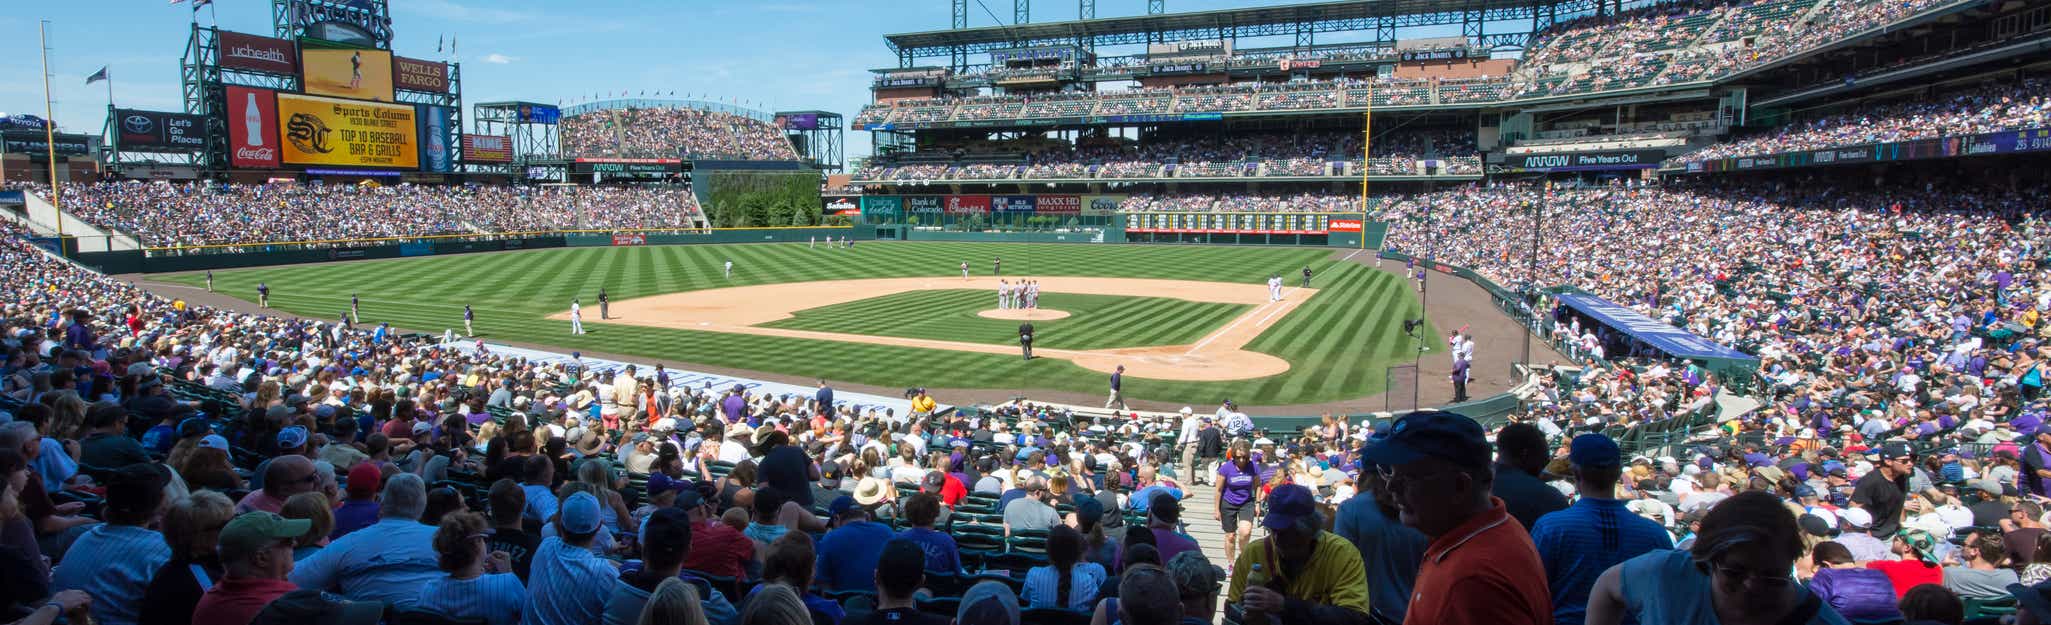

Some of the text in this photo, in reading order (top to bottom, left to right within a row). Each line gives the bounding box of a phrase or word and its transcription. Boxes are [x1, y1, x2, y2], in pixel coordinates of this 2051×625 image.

[231, 44, 285, 62] uchealth
[400, 61, 440, 76] WELLS
[400, 72, 441, 87] FARGO
[334, 104, 411, 121] Sports Column
[10, 118, 42, 127] TOYOTA
[169, 118, 192, 127] Let's
[169, 127, 184, 135] Go
[170, 136, 203, 145] Places
[340, 129, 408, 145] TOP 10 BASEBALL
[237, 147, 273, 160] Coca-Cola
[350, 143, 401, 157] BAR & GRILLS
[1525, 154, 1638, 167] ARROW Five Years Out
[593, 164, 624, 172] ARROW
[929, 198, 937, 206] of
[1038, 197, 1080, 206] MAXX HD
[1233, 420, 1241, 428] 12
